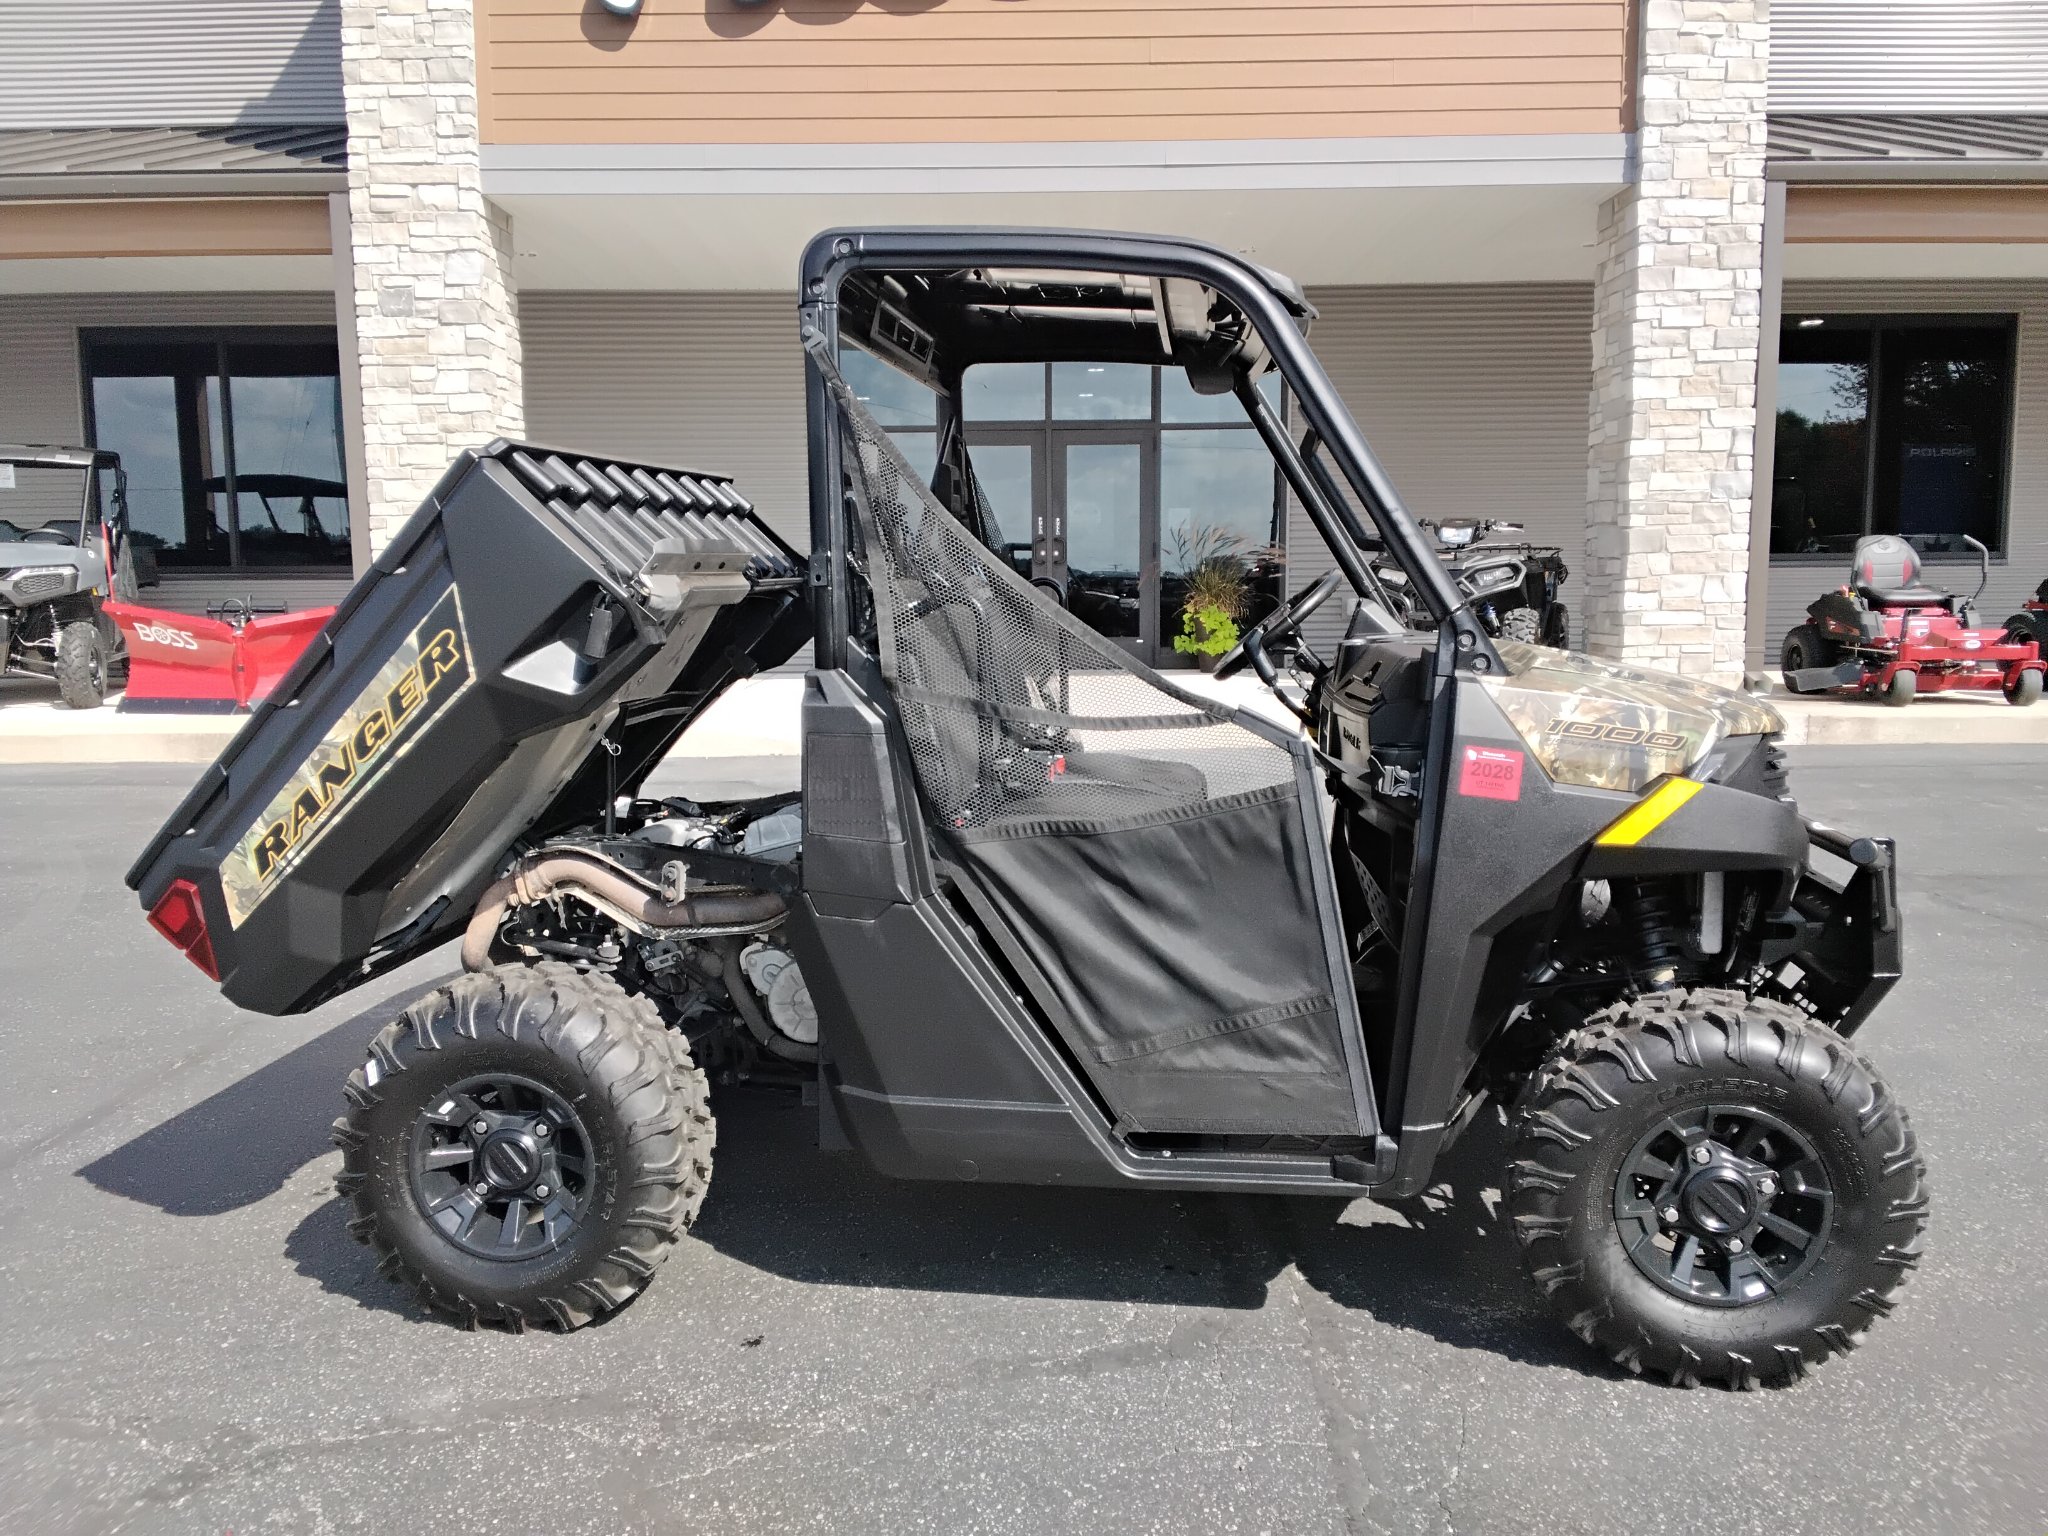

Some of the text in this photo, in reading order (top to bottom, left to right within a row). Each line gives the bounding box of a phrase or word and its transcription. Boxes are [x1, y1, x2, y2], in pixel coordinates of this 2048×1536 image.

[132, 622, 199, 650] BOSS
[1545, 717, 1688, 751] 1000
[253, 629, 460, 881] RANGER
[1470, 761, 1514, 781] 2028
